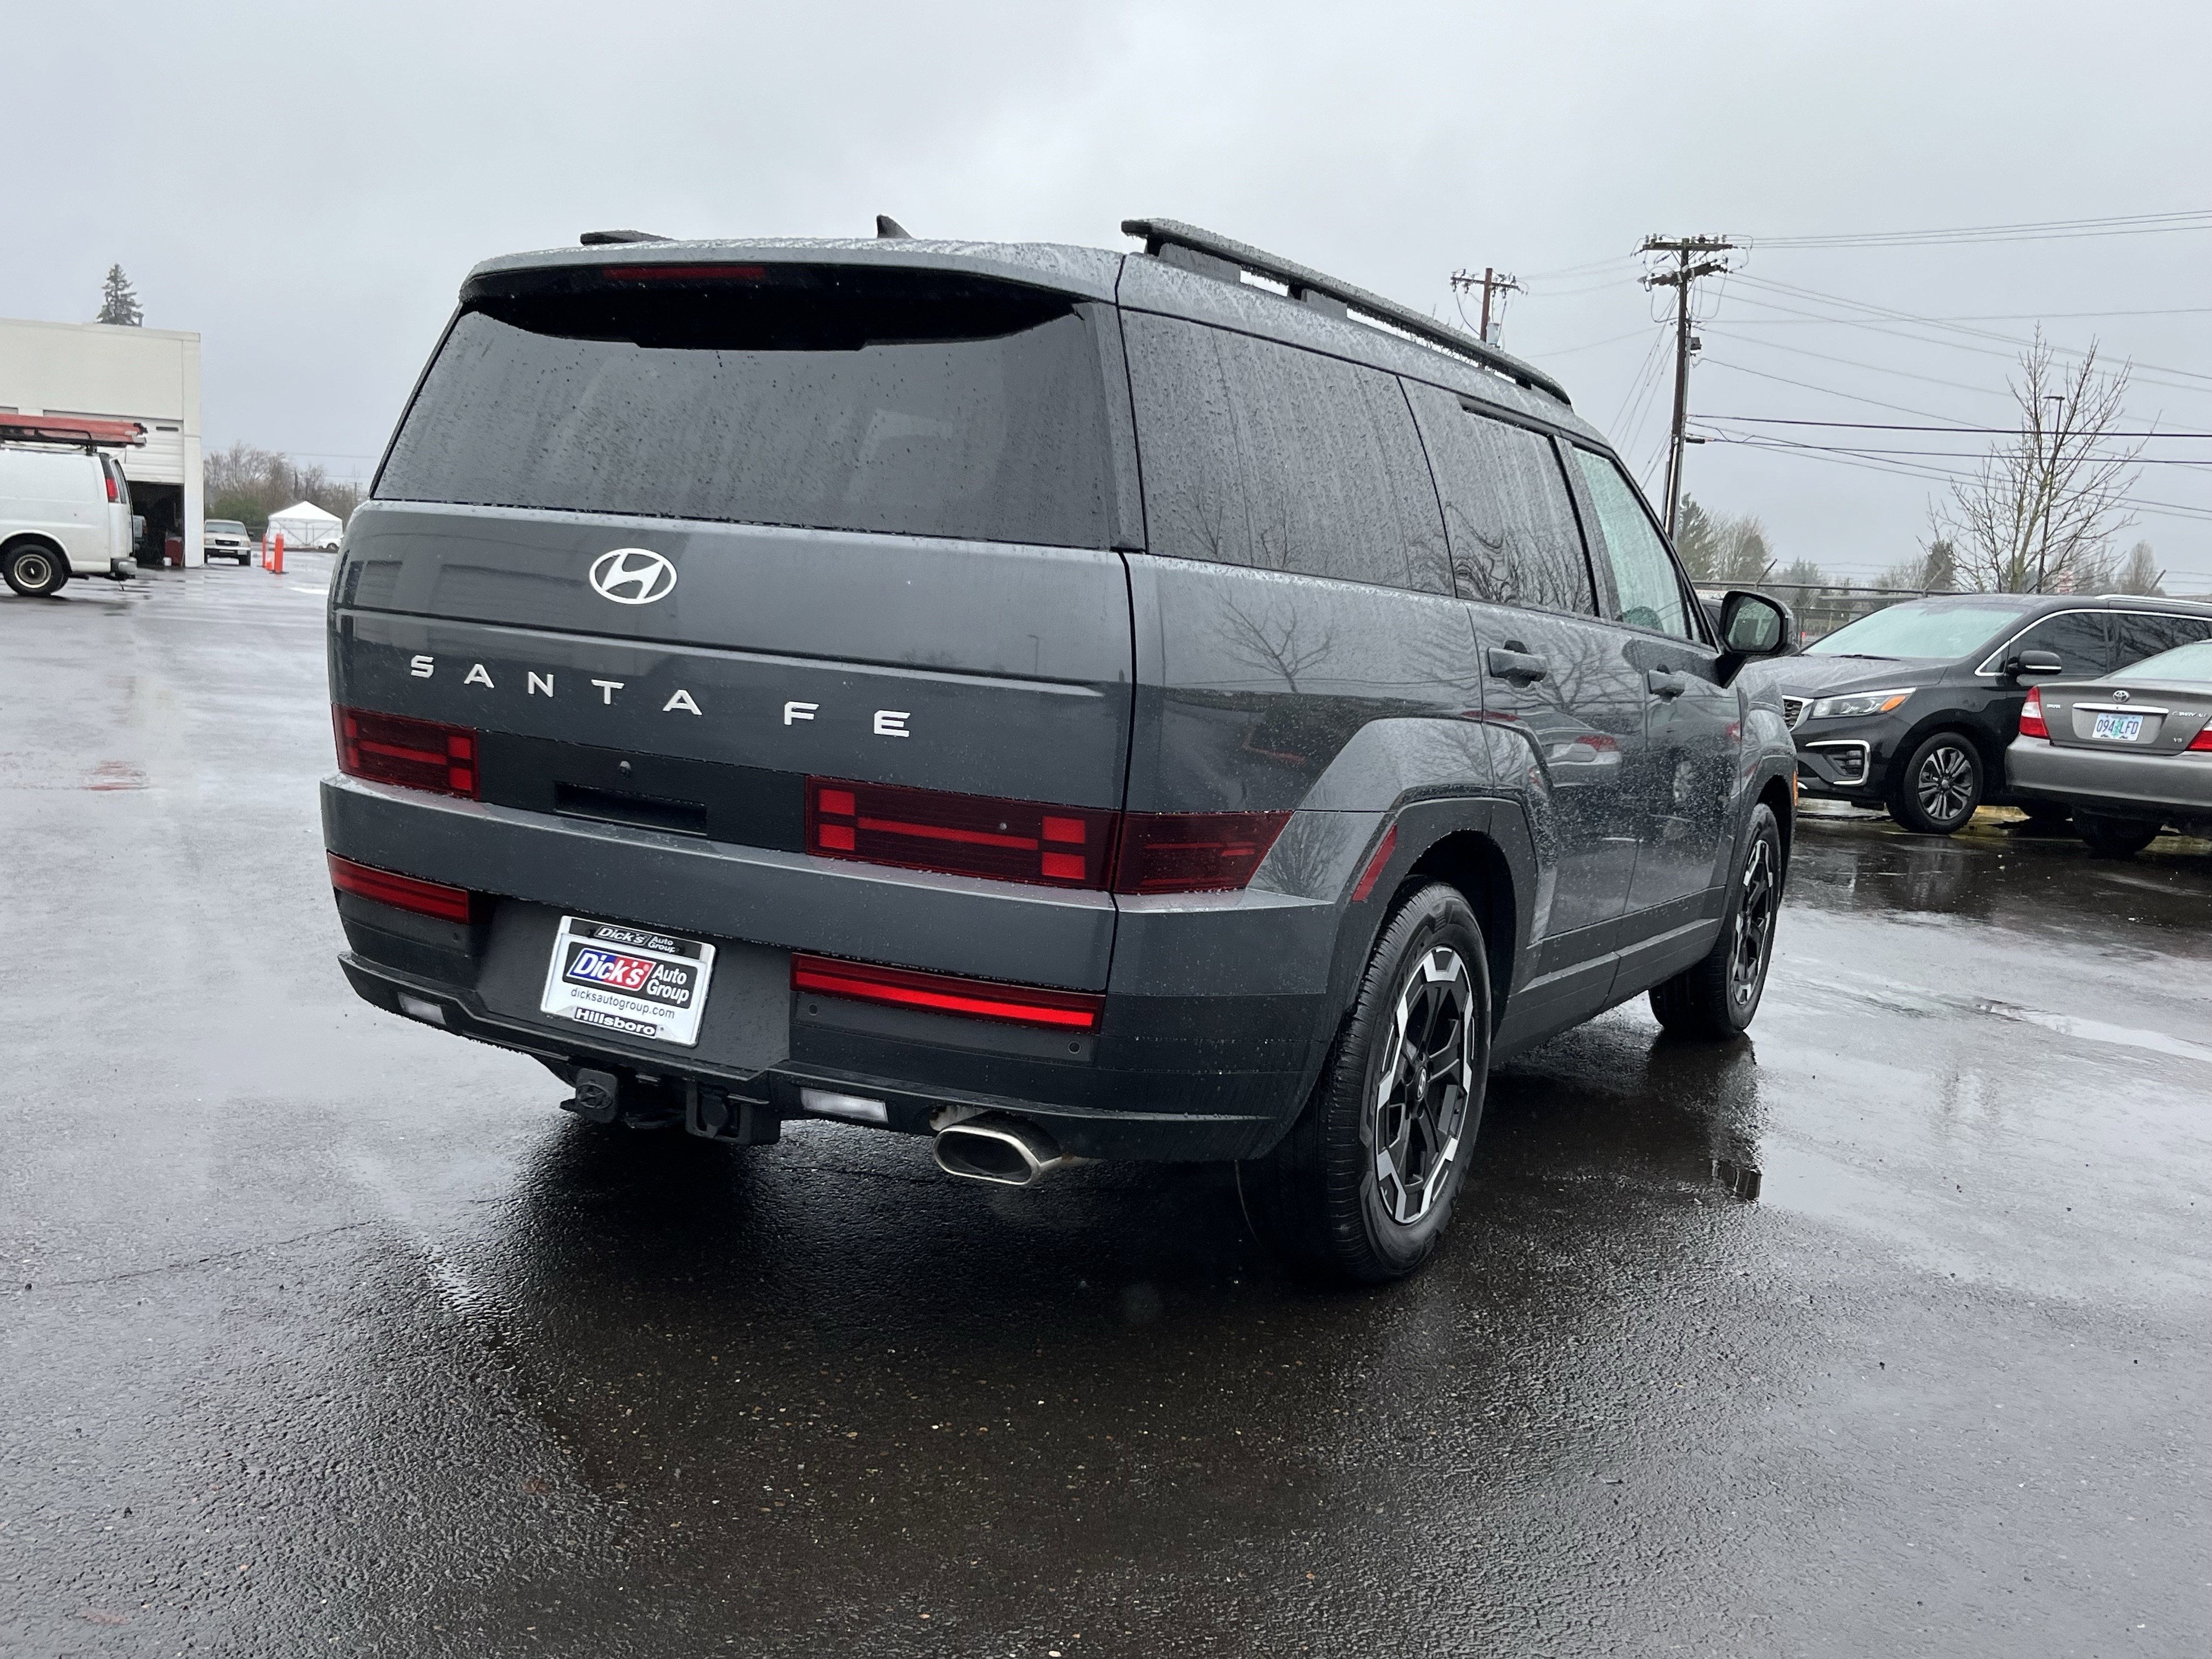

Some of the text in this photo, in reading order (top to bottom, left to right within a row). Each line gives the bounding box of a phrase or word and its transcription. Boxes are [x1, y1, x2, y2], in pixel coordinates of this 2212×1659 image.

[410, 654, 911, 737] SANTA FE
[2096, 719, 2138, 734] 094 LFD
[597, 928, 645, 944] Dick's
[650, 936, 674, 945] Auto
[573, 952, 645, 986] Dick's
[651, 964, 687, 985] Auto
[571, 987, 675, 1019] dicksautogroup.com
[646, 978, 690, 1005] Group
[575, 1008, 656, 1036] Hillsboro
